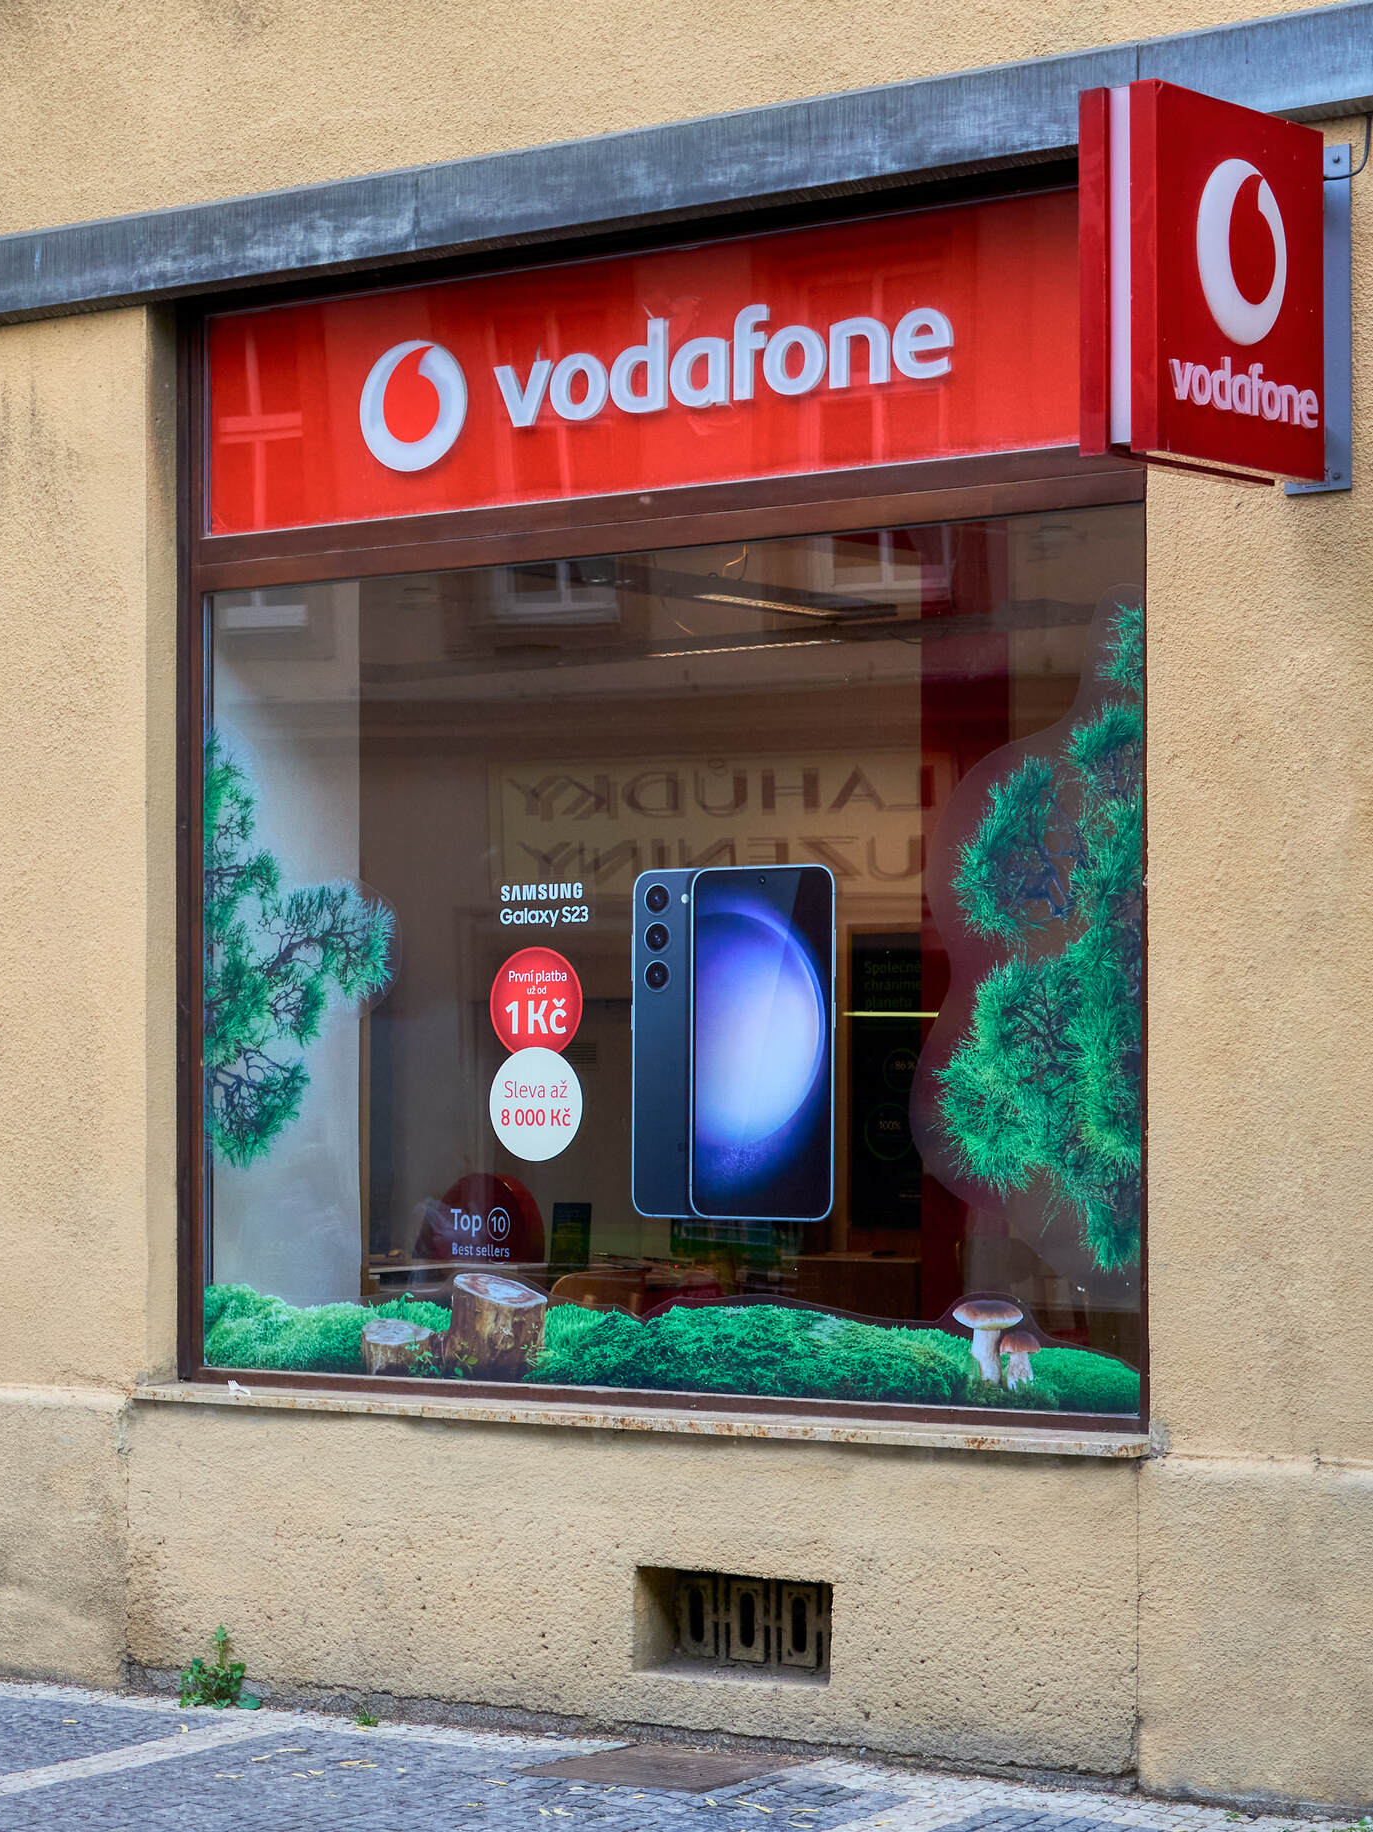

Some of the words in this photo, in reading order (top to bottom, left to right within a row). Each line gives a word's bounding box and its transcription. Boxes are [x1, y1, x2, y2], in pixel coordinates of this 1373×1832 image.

[494, 303, 955, 428] vodafone
[1169, 356, 1319, 429] vodafone
[500, 882, 583, 902] SAMSUNG
[500, 907, 559, 928] Galaxy
[561, 905, 589, 924] S23
[508, 969, 534, 983] První
[535, 969, 568, 985] platba
[526, 985, 536, 995] už
[537, 985, 547, 995] od
[505, 1000, 519, 1035] 1
[528, 998, 568, 1035] Kč
[504, 1080, 546, 1099] Sleva
[550, 1079, 568, 1099] až
[501, 1108, 510, 1127] 8
[514, 1108, 546, 1127] 000
[550, 1107, 571, 1127] Kč
[450, 1208, 482, 1238] Top
[491, 1216, 506, 1233] 10
[451, 1242, 474, 1256] Best
[475, 1243, 510, 1259] sellers
